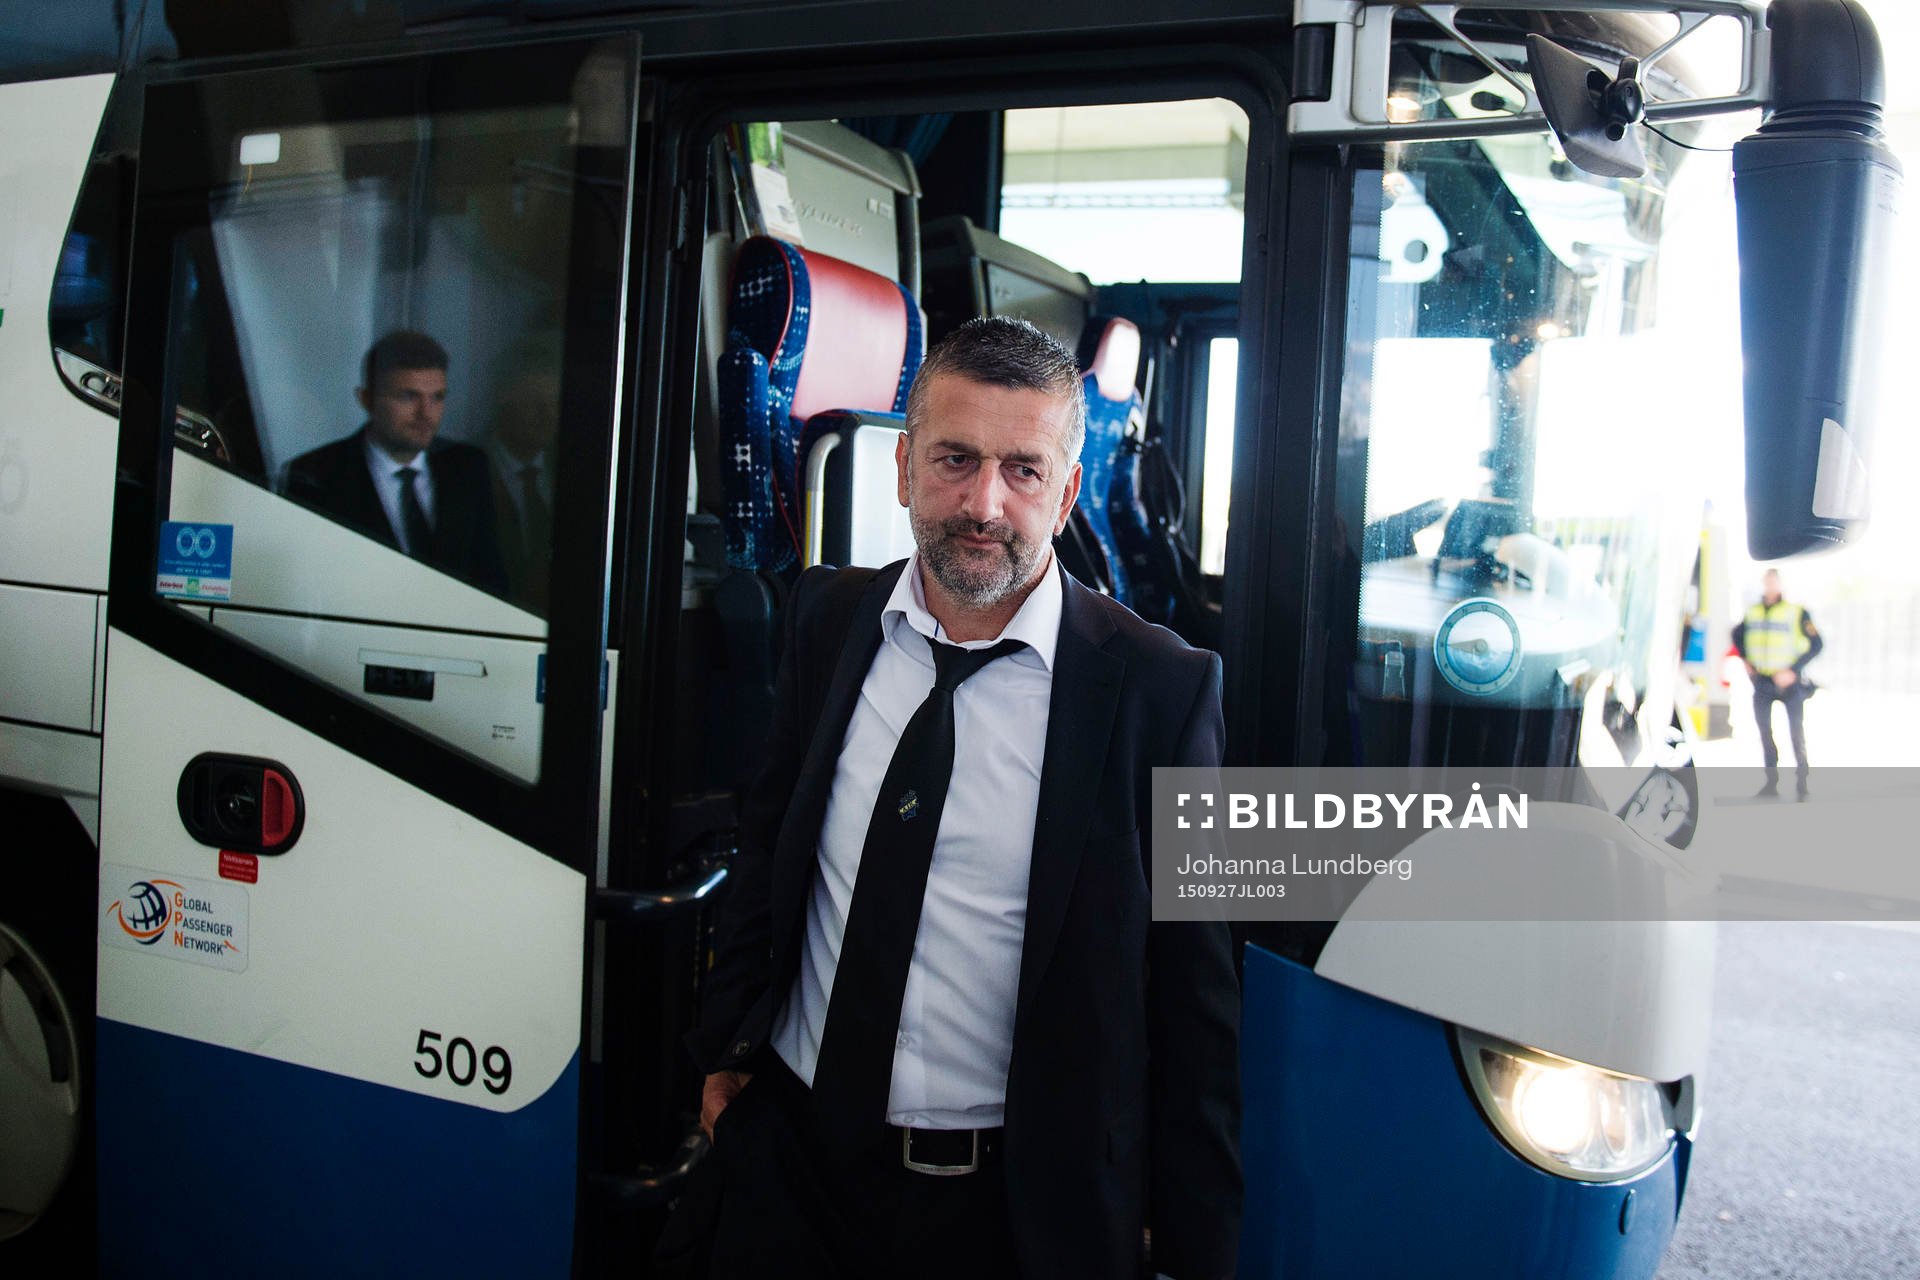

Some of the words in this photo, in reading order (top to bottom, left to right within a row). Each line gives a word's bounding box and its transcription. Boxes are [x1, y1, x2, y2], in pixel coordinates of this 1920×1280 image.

[174, 891, 214, 914] GLOBAL
[174, 911, 233, 937] PASSENGER
[414, 1029, 512, 1095] 509
